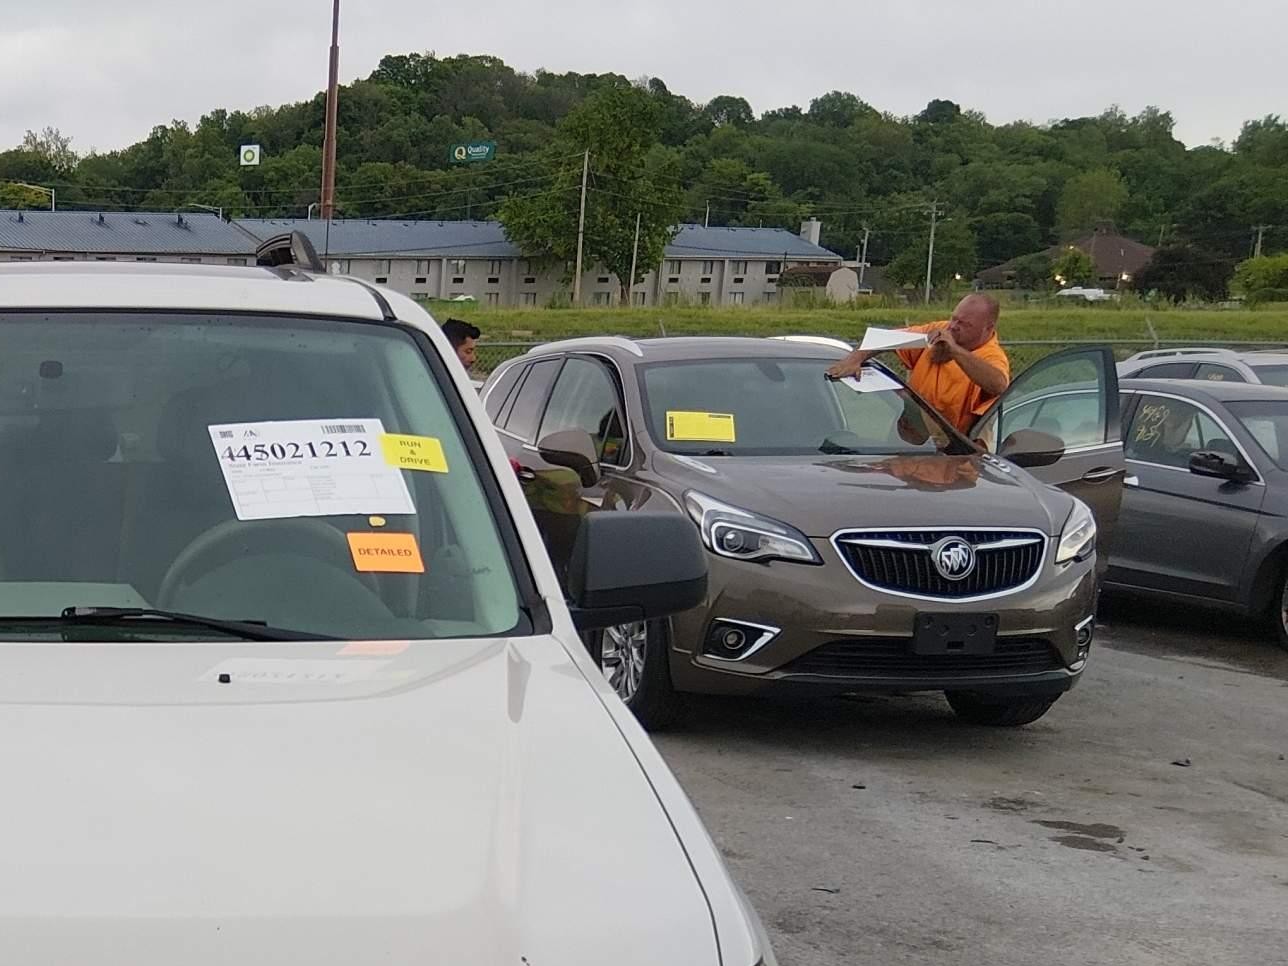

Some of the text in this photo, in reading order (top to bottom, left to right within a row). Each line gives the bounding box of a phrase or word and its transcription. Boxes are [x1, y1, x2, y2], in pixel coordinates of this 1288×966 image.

[467, 145, 490, 154] Quality
[399, 440, 422, 448] RUN
[221, 440, 372, 461] 445021212
[399, 456, 431, 466] DRIVE
[358, 547, 413, 557] DETAILED
